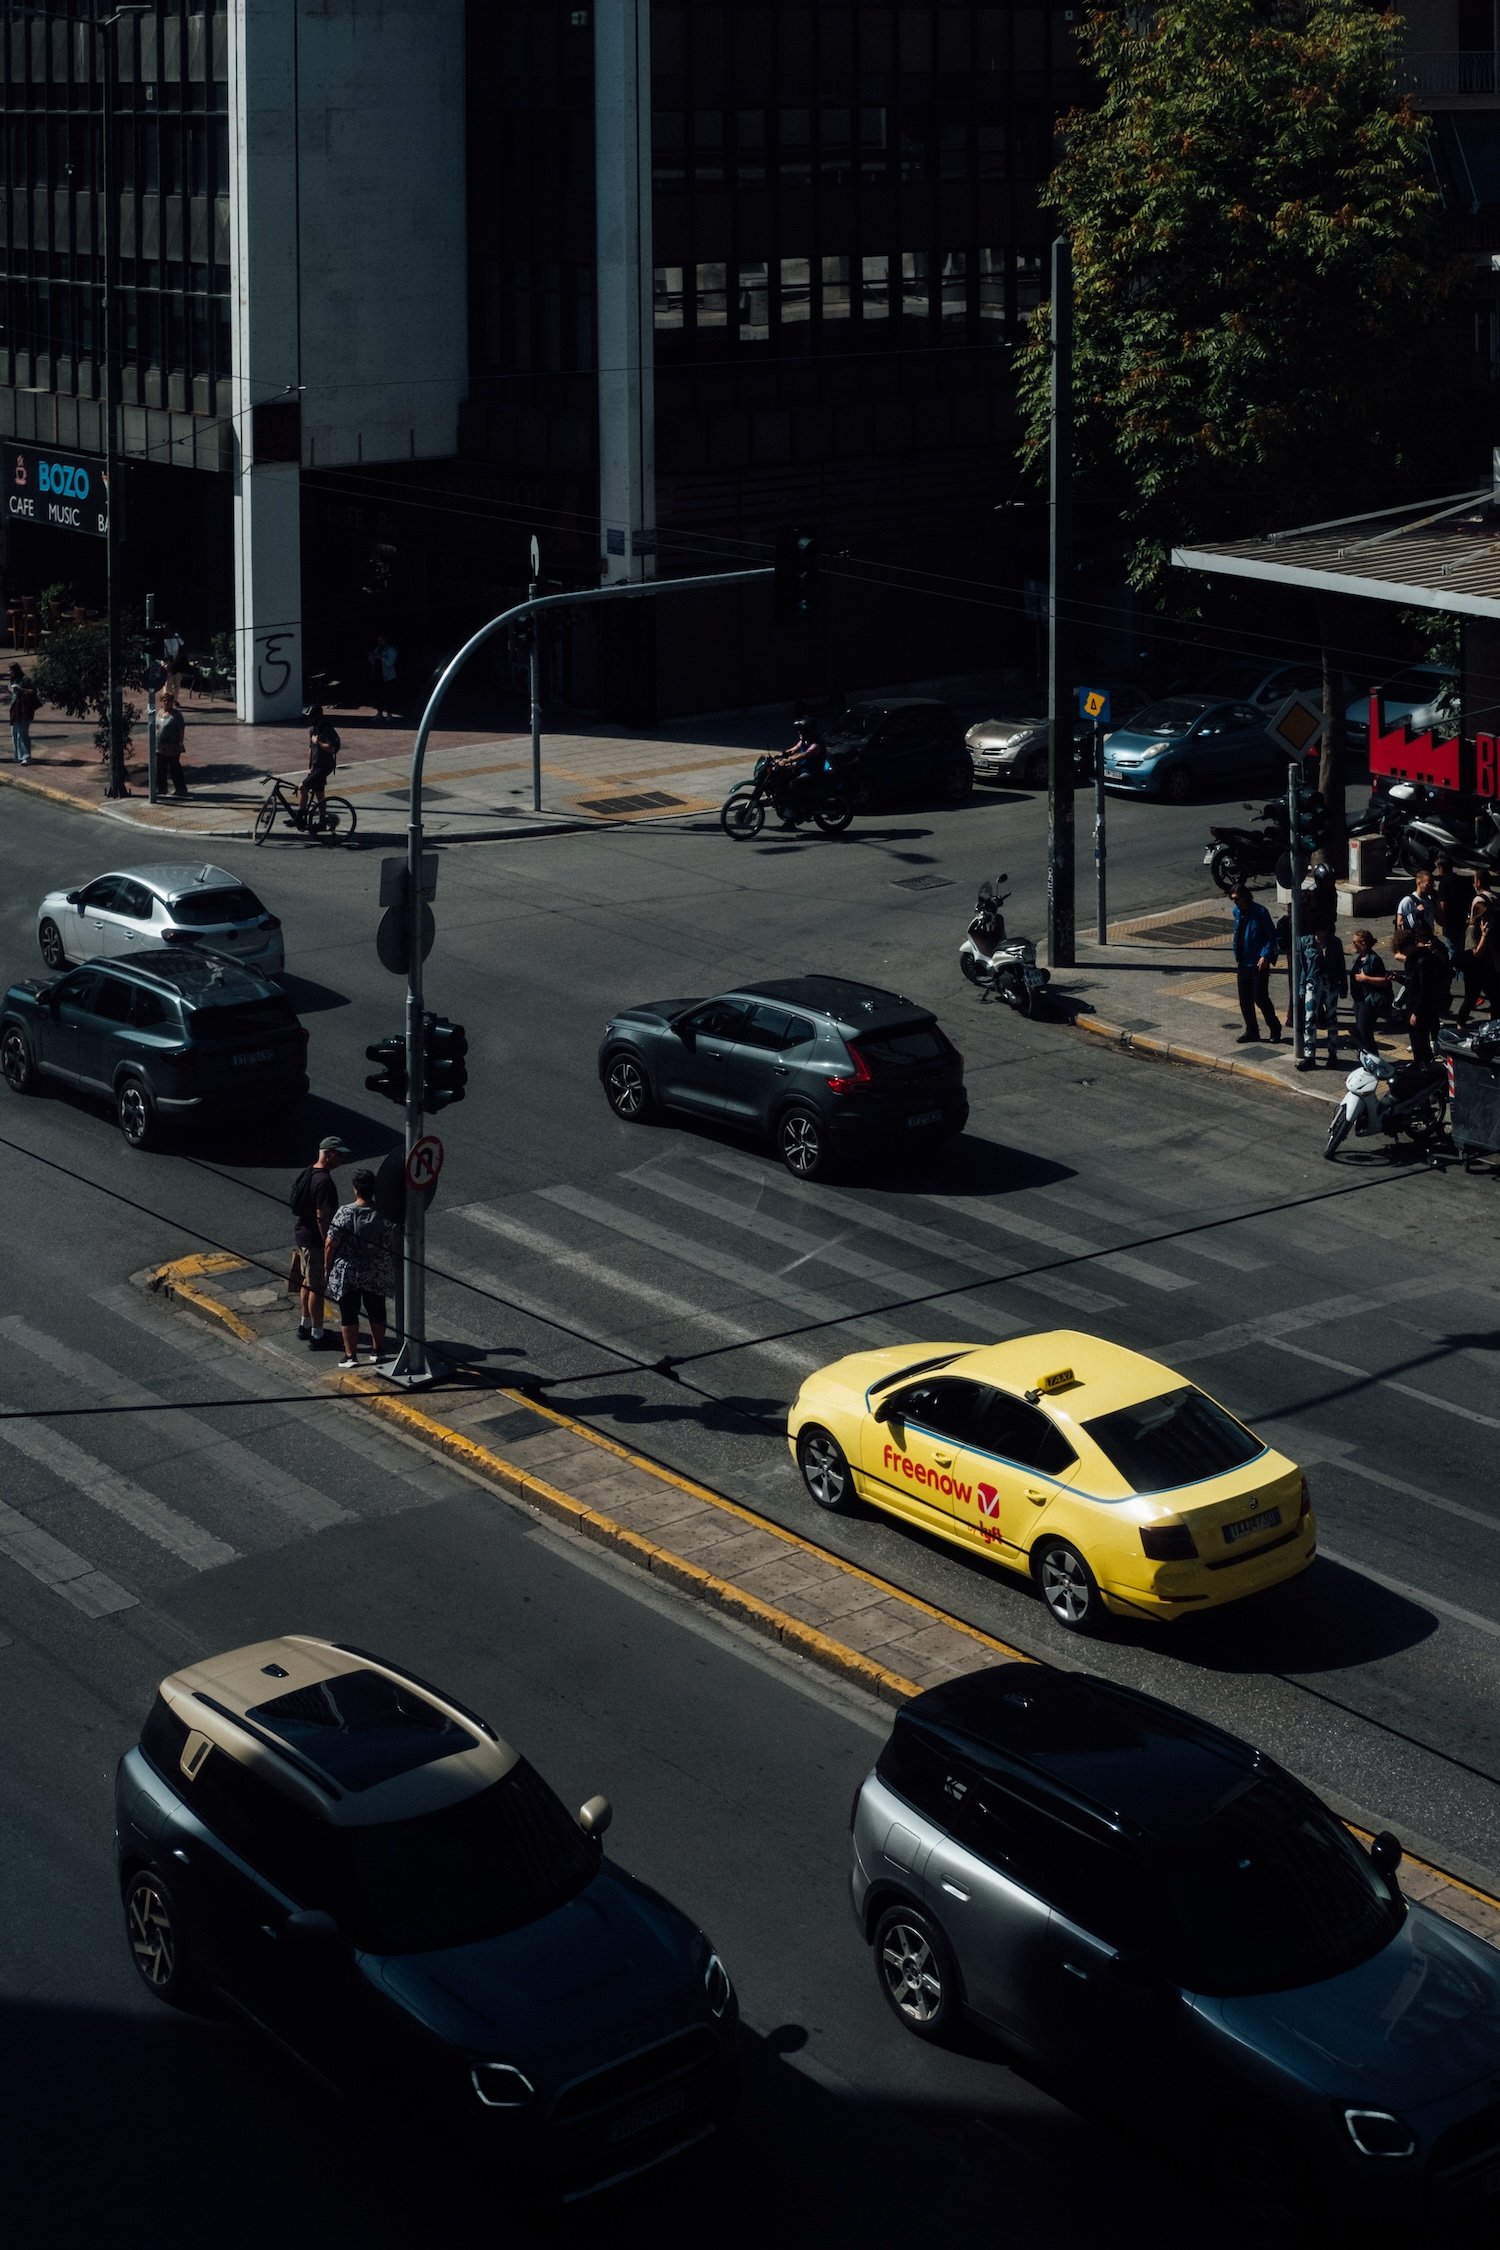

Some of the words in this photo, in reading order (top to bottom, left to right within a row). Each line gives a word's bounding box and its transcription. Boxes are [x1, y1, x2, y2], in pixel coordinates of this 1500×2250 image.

[38, 460, 90, 500] BOZO
[9, 495, 34, 517] CAFE
[48, 503, 81, 526] MUSIC
[1048, 1371, 1072, 1387] TAXI
[883, 1444, 972, 1504] freenow
